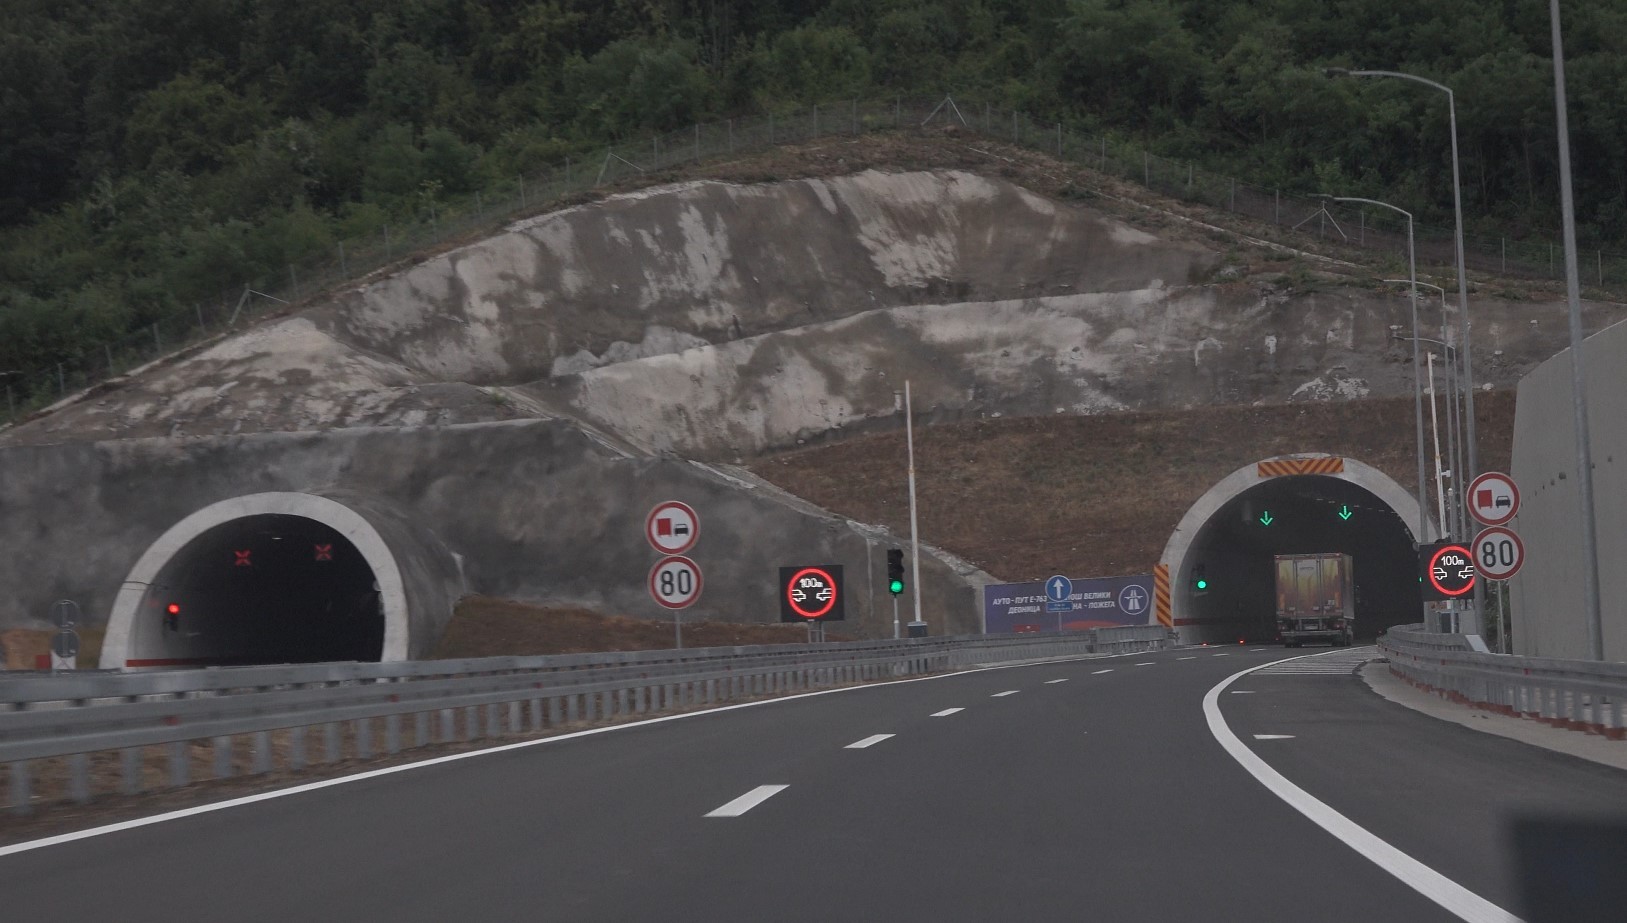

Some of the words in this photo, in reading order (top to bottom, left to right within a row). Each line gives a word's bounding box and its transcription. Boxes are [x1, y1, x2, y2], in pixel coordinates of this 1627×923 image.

[1441, 556, 1465, 566] 100m
[1482, 540, 1514, 568] 80
[660, 569, 692, 597] 80
[799, 577, 823, 588] 100m
